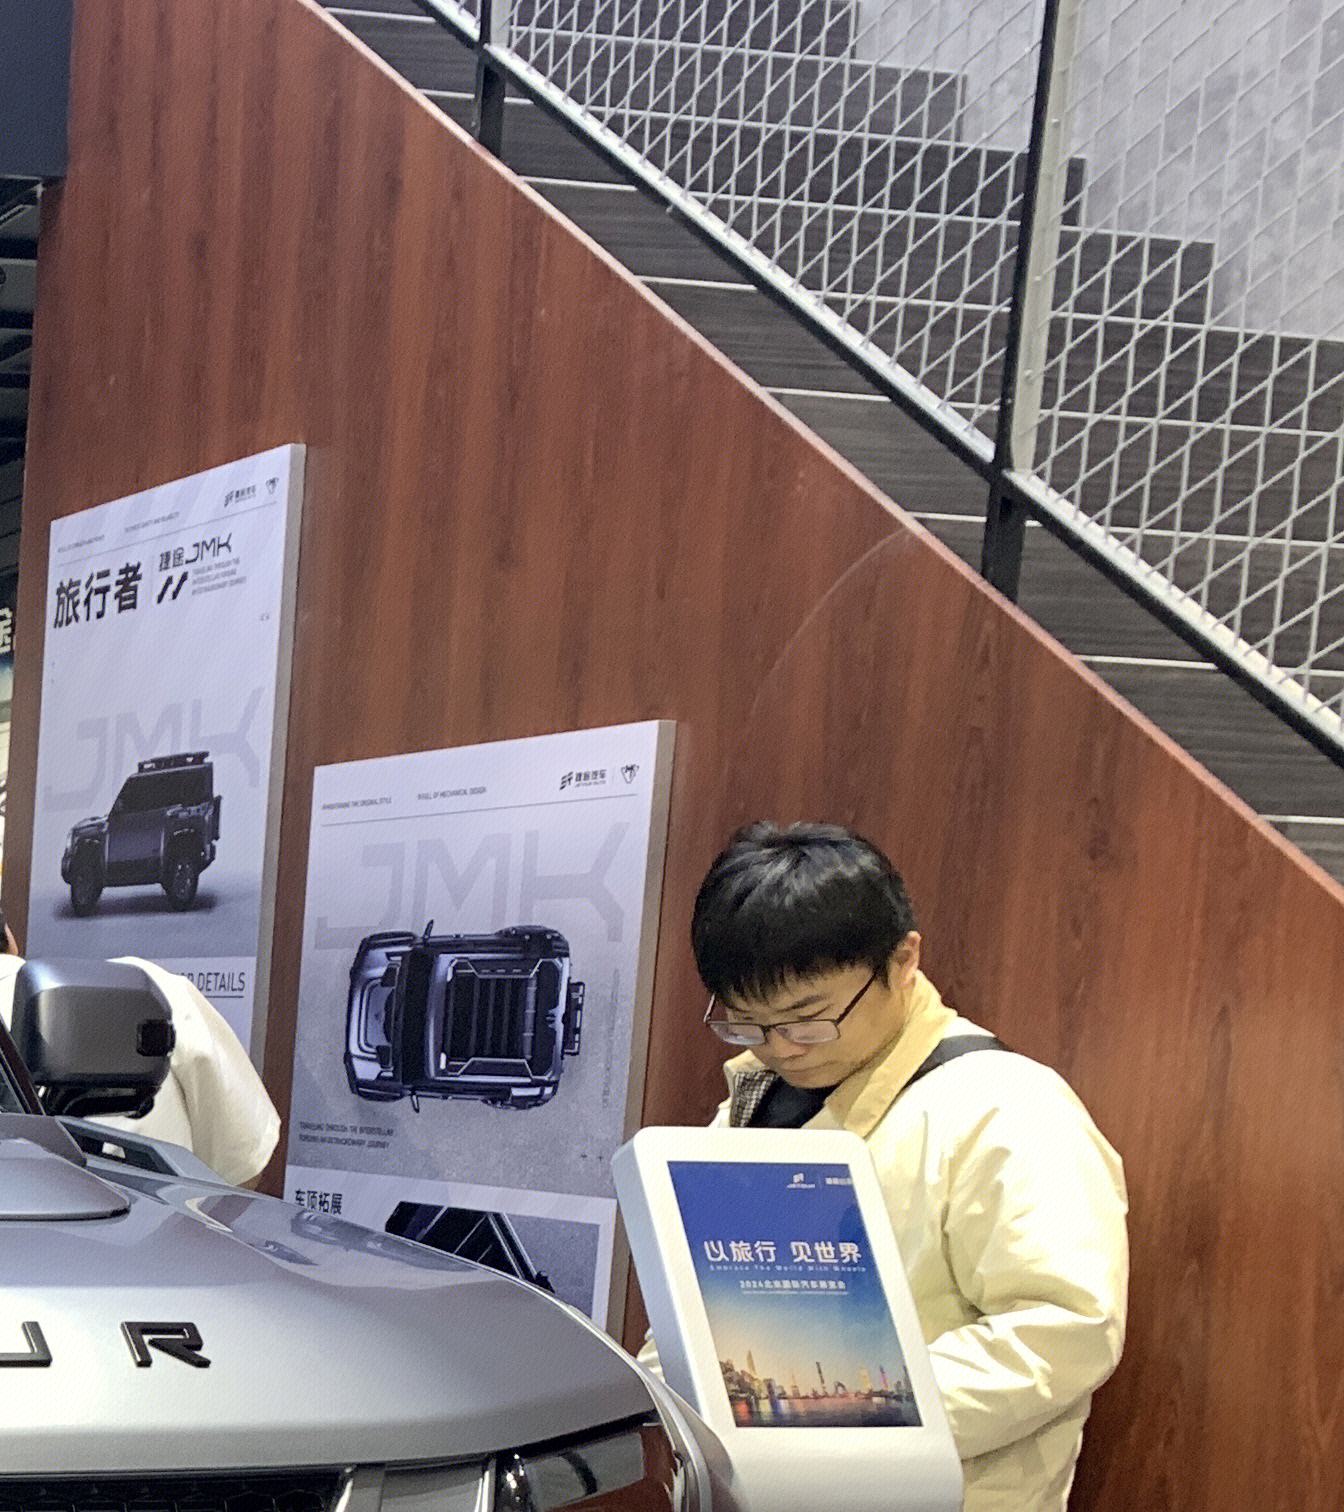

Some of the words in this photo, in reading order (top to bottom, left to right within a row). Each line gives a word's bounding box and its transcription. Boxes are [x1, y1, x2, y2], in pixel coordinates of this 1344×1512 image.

[54, 561, 143, 629] 旅行者
[197, 972, 246, 992] DETAILS
[295, 1188, 342, 1214] 车顶拓展
[703, 1240, 777, 1262] 以旅行
[790, 1240, 862, 1264] 见世界
